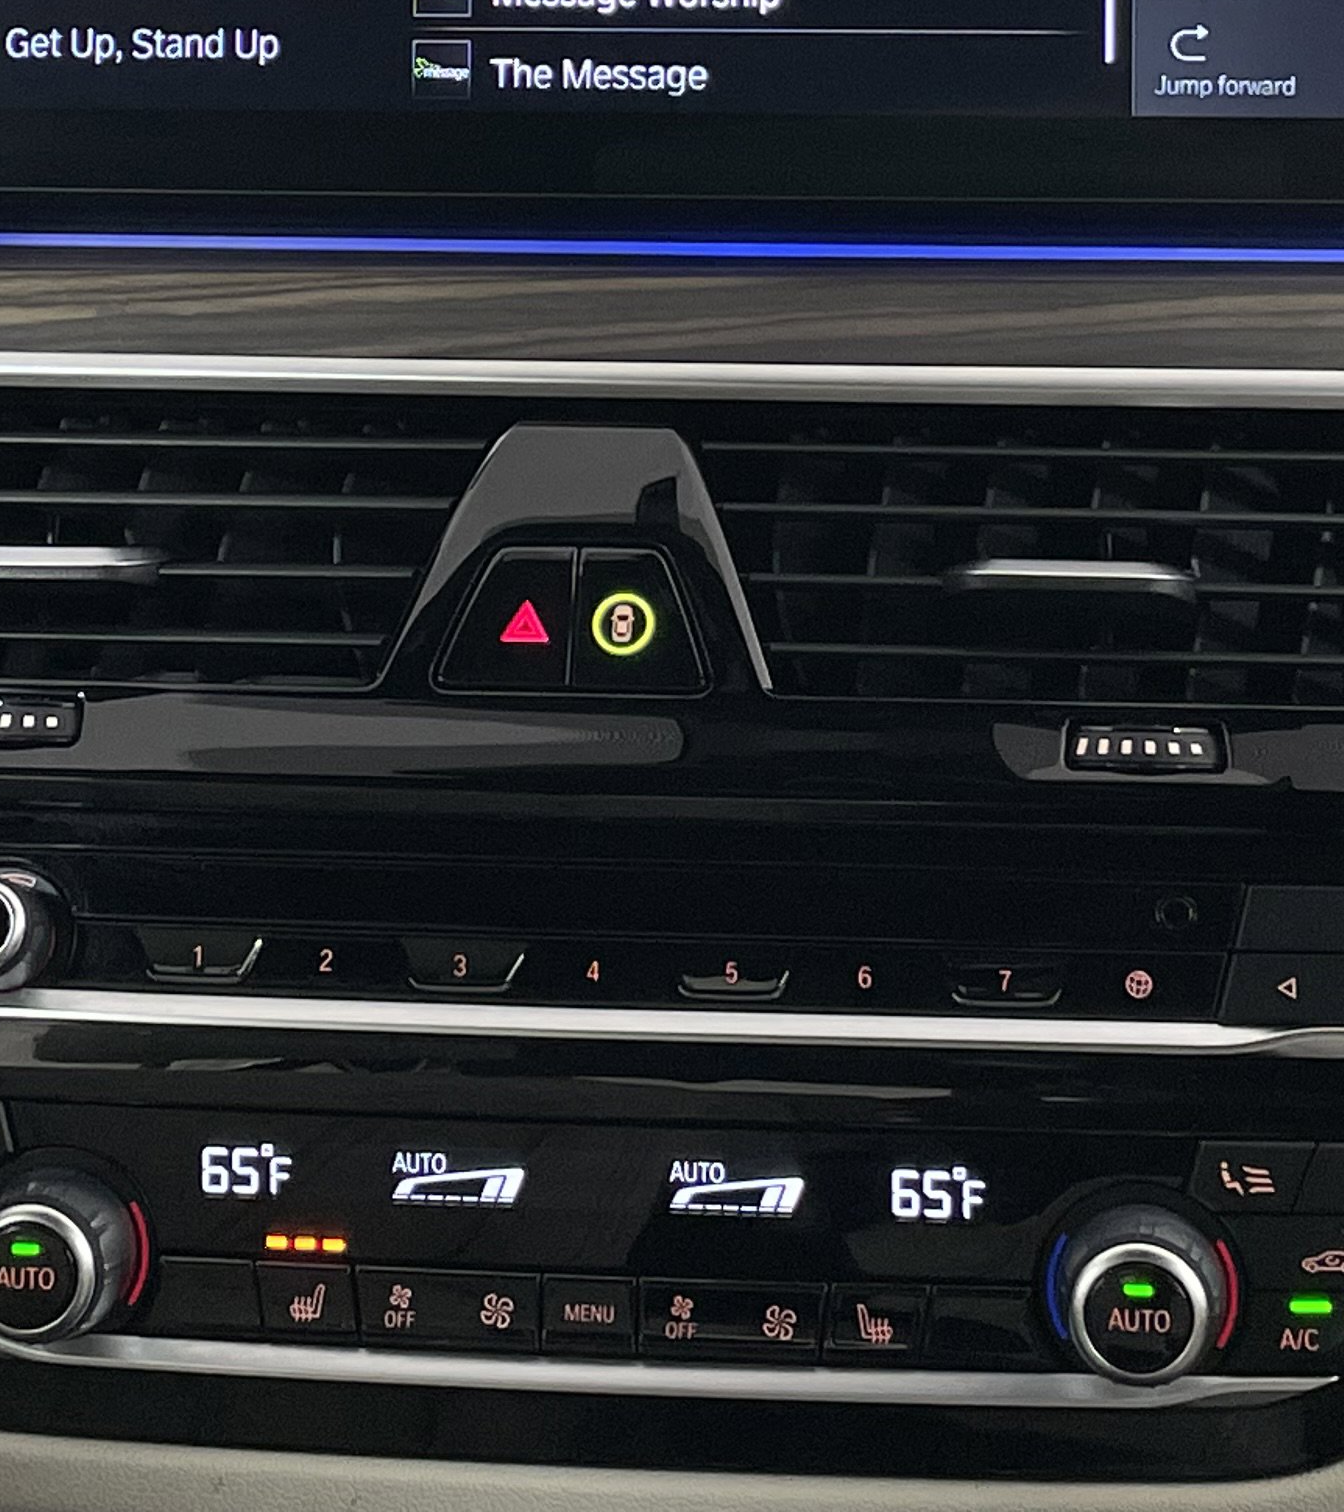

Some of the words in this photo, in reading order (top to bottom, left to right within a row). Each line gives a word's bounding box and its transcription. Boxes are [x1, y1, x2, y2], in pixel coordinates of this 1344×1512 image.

[5, 27, 63, 59] Get
[70, 27, 123, 65] Up,
[131, 27, 225, 60] Stand
[234, 28, 281, 66] Up
[489, 57, 554, 90] The
[562, 58, 710, 97] Message
[1154, 74, 1214, 99] Jump
[1216, 74, 1296, 96] forward
[193, 945, 202, 967] 1
[319, 948, 333, 972] 2
[453, 954, 467, 977] 3
[586, 960, 600, 982] 4
[724, 961, 738, 985] 5
[857, 965, 872, 989] 6
[999, 969, 1012, 992] 7
[391, 1151, 448, 1175] AUTO
[669, 1159, 726, 1184] AUTO
[383, 1305, 416, 1328] OFF
[564, 1303, 615, 1324] MENU
[1108, 1307, 1171, 1333] AUTO
[664, 1316, 701, 1340] OFF
[1280, 1328, 1320, 1351] A/C
